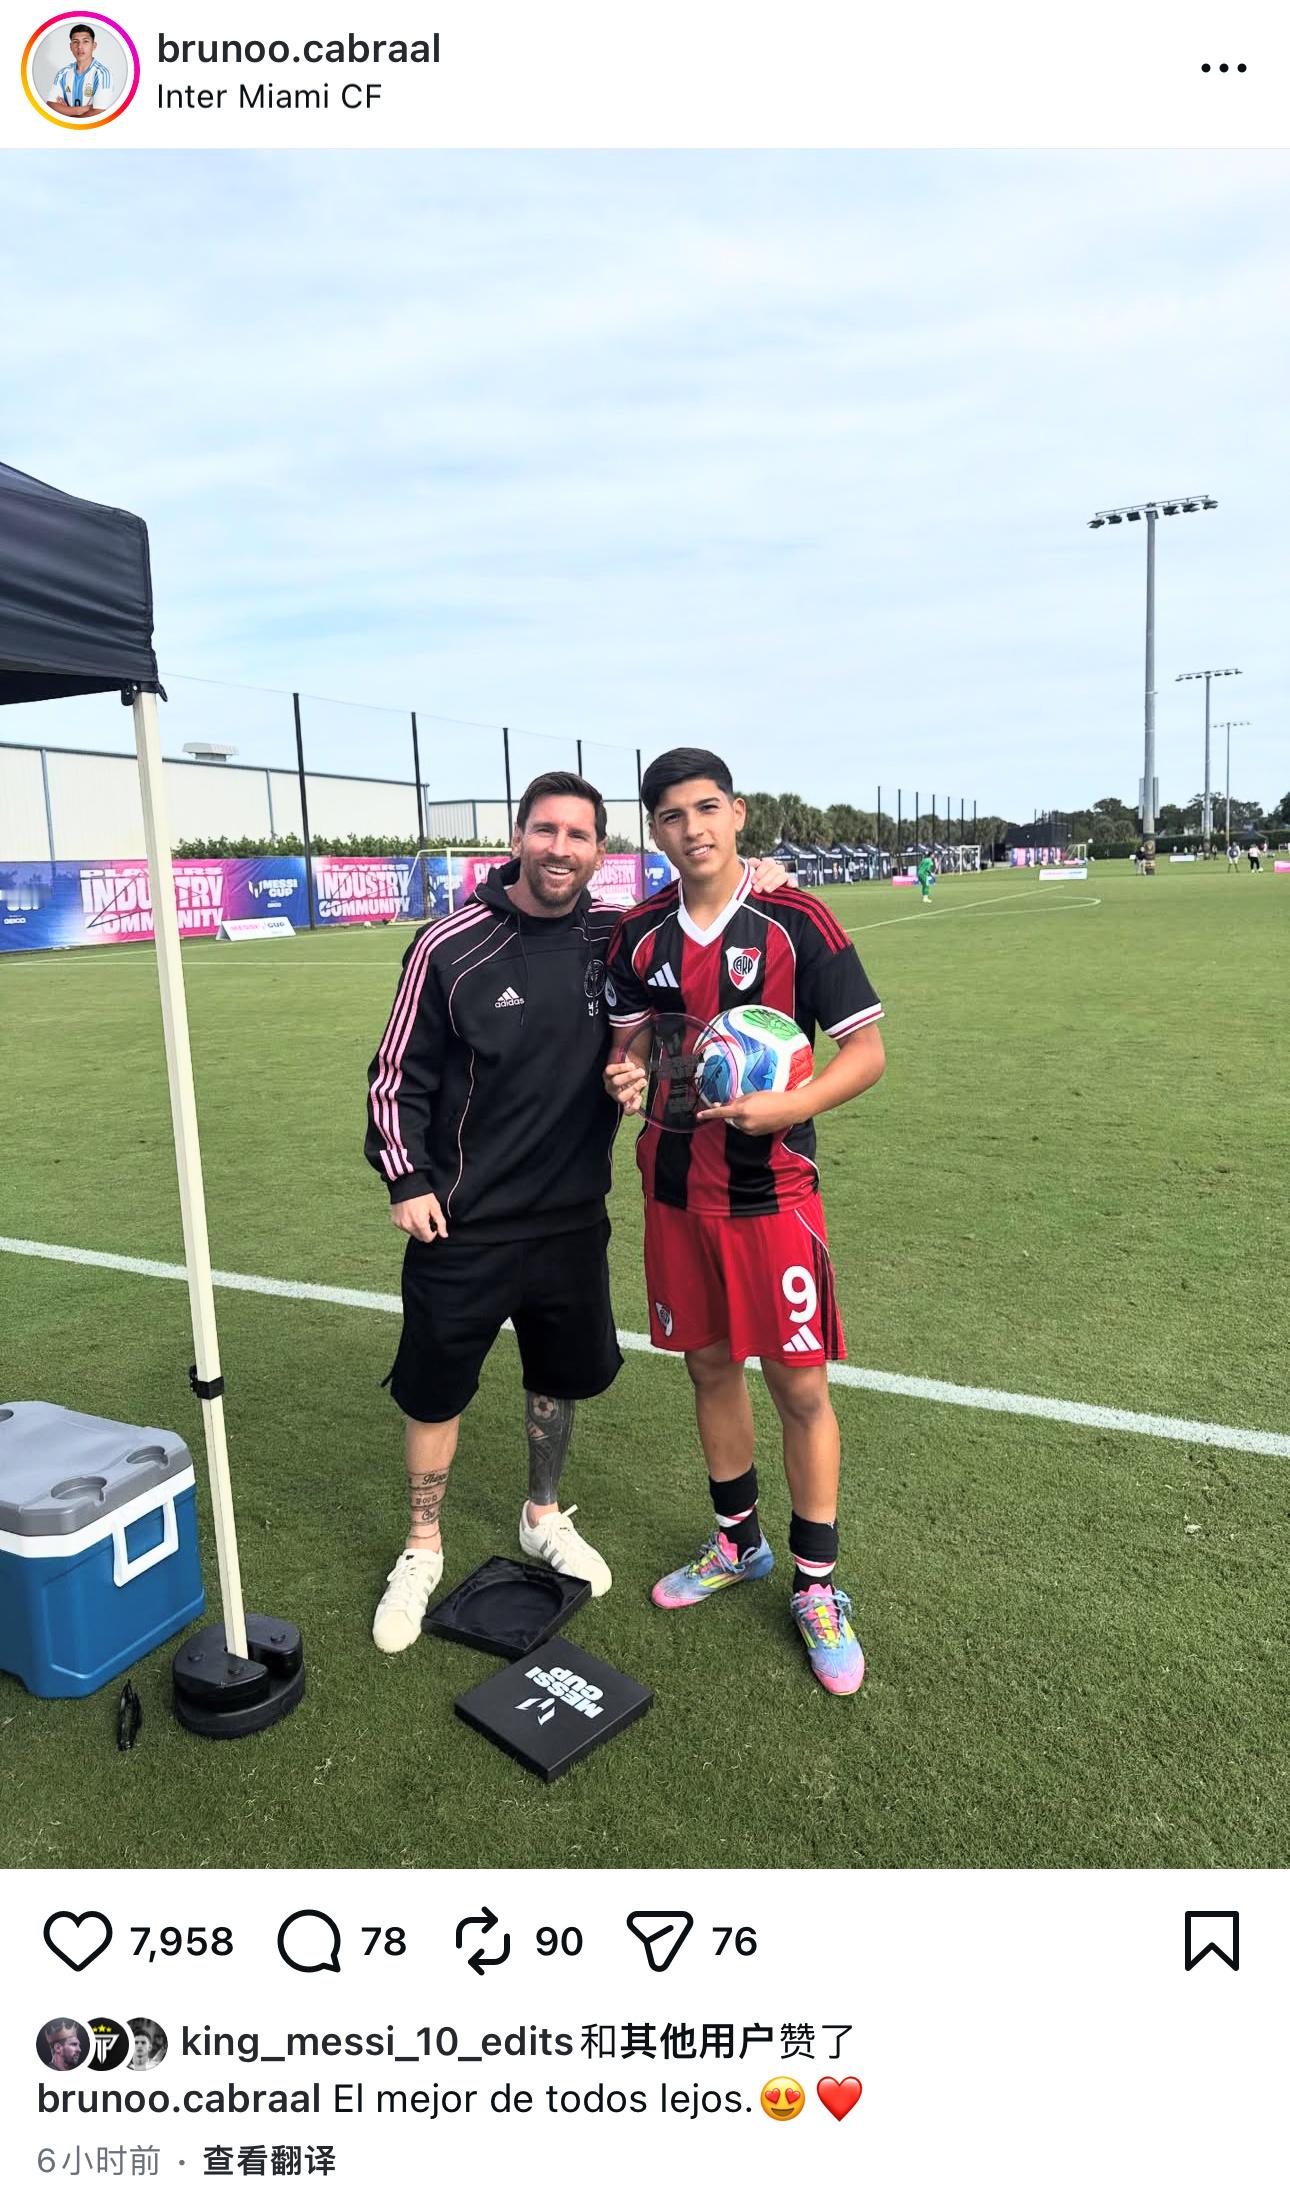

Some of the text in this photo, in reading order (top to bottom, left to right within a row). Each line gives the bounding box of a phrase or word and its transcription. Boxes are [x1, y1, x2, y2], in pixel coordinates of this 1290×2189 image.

[262, 878, 298, 889] MESSI
[268, 887, 293, 898] CUP
[316, 871, 410, 900] INDUSTRY
[318, 897, 410, 918] COMMUNITY
[494, 997, 525, 1008] adidas
[782, 1265, 817, 1324] 9
[524, 1666, 605, 1719] MESSI
[549, 1666, 604, 1702] CUP
